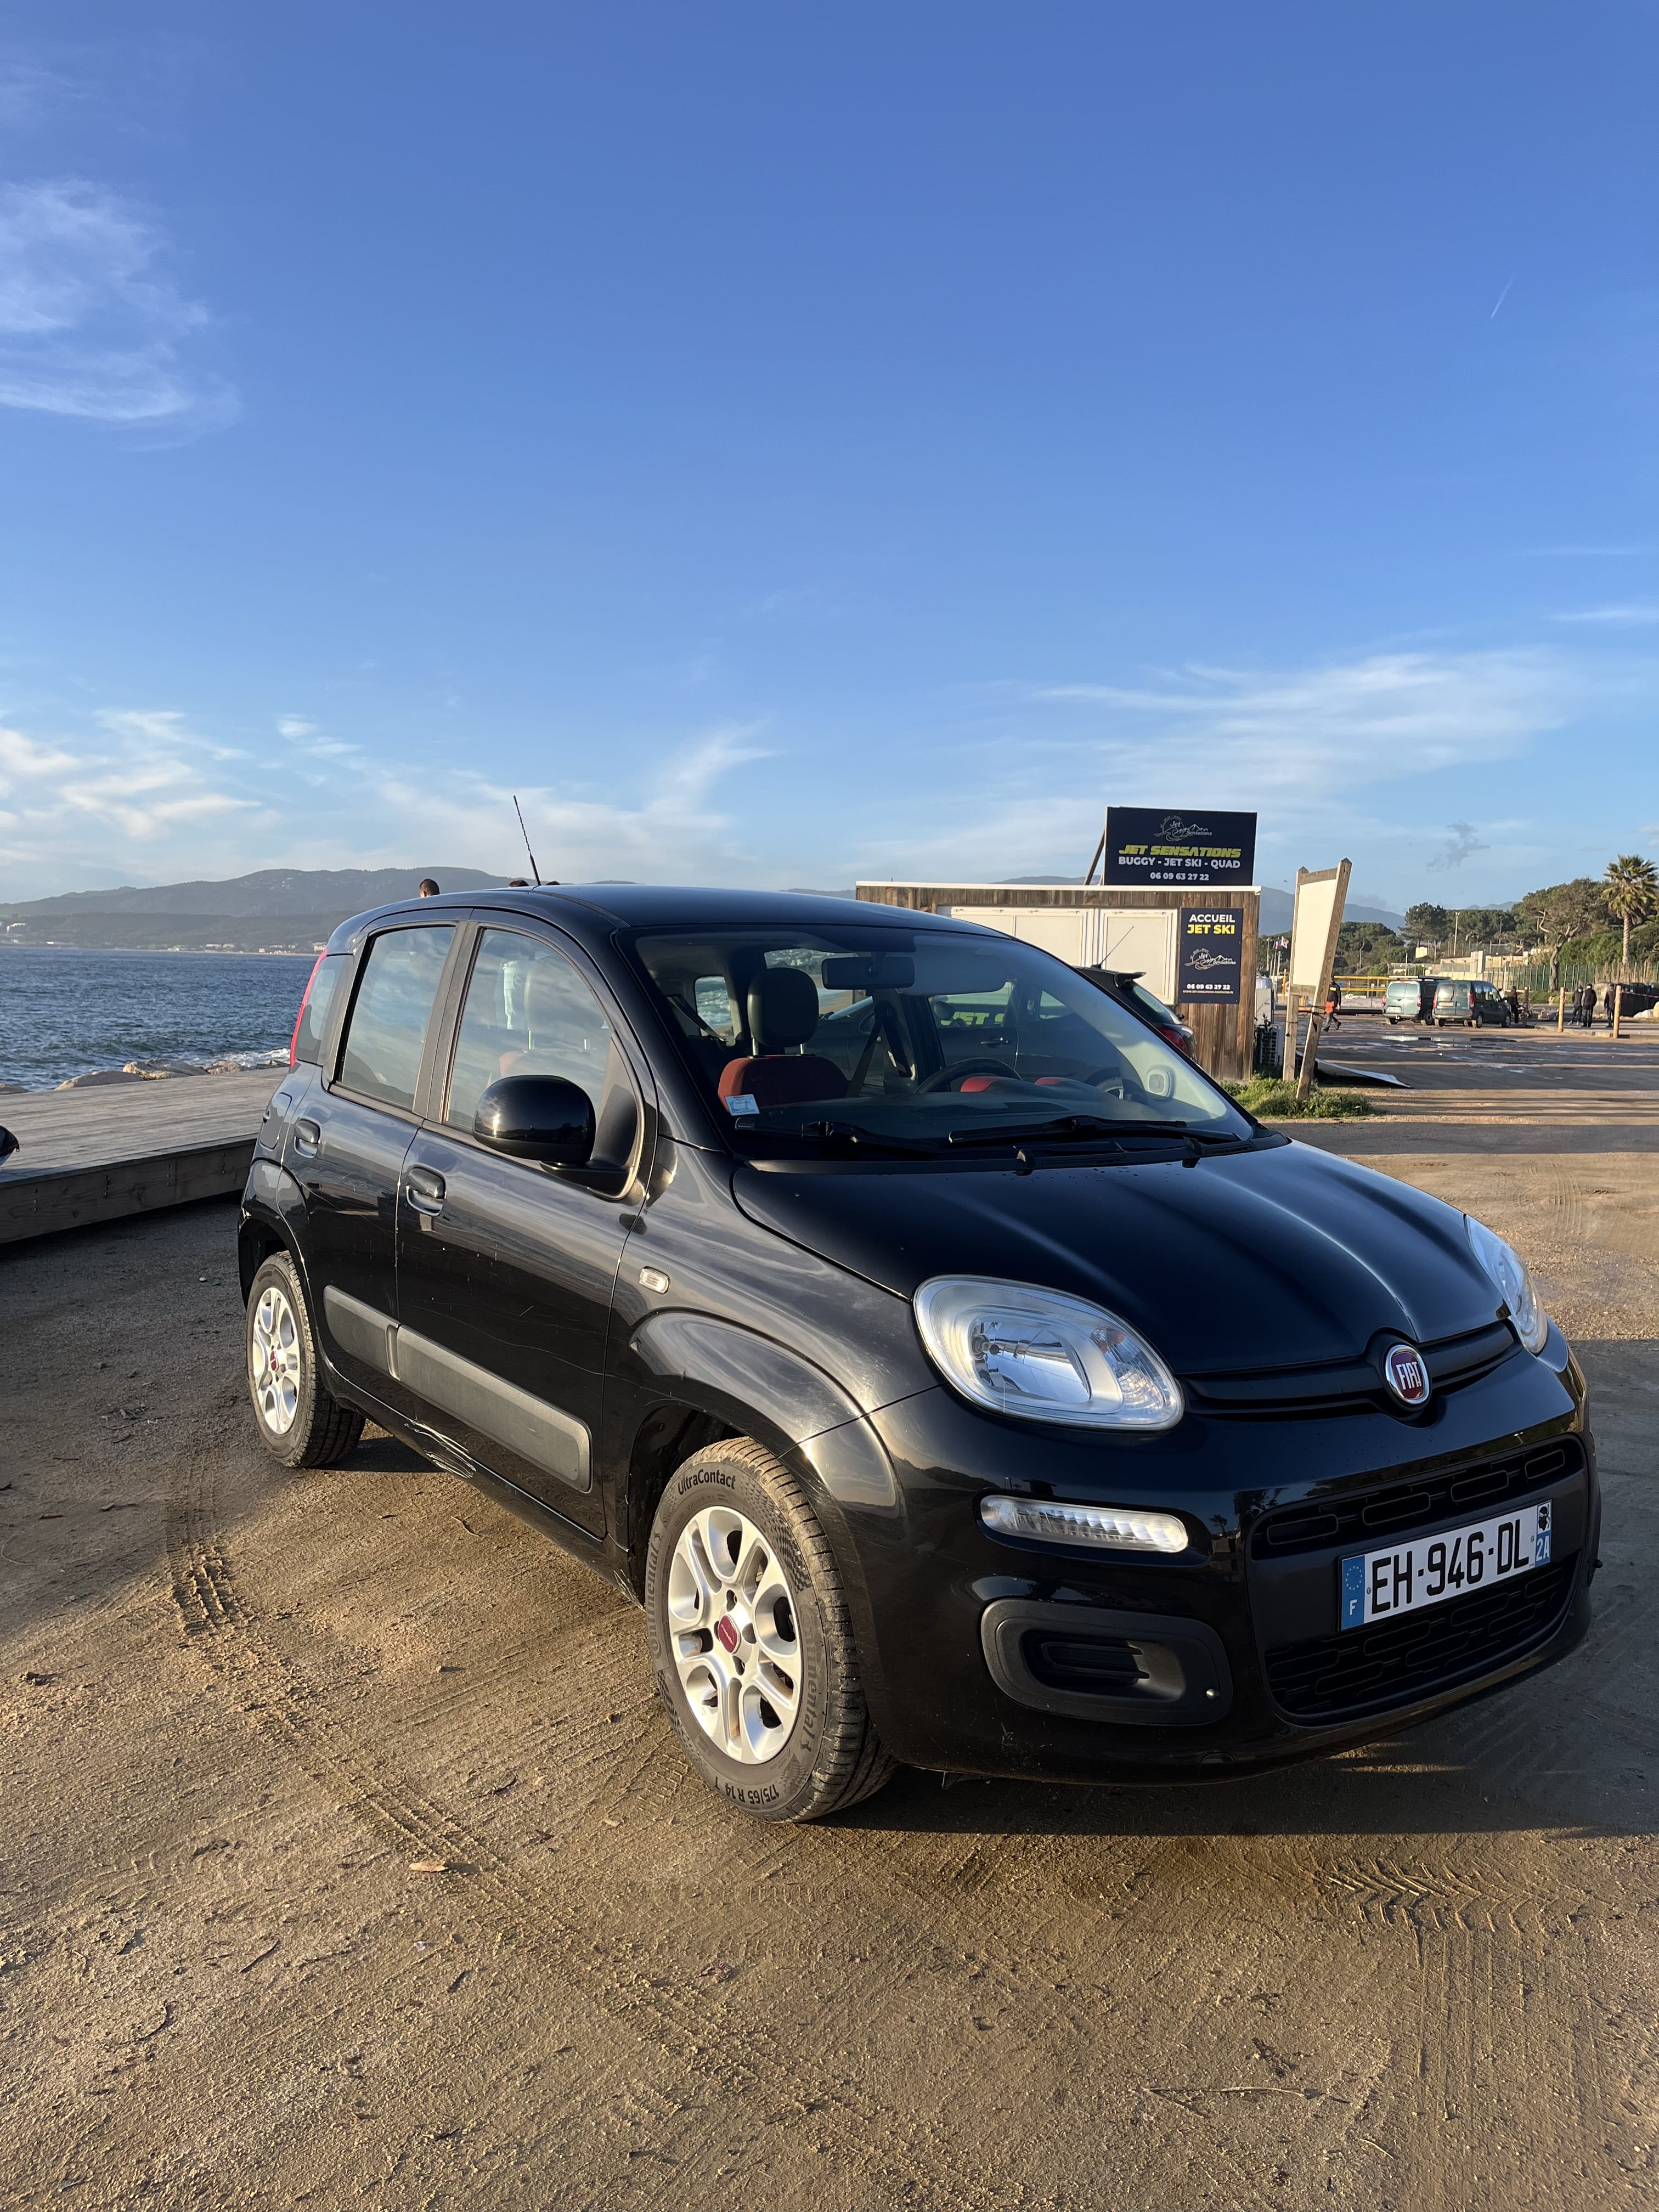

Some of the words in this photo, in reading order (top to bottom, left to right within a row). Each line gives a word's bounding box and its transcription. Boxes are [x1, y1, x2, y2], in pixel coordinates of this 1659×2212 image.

[1119, 845, 1148, 855] JET
[1150, 845, 1242, 858] SENSATIONS
[1118, 856, 1155, 866] BUGGY
[1164, 857, 1183, 866] JET
[1184, 859, 1202, 867] SKI
[1210, 859, 1240, 870] QUAD
[1189, 914, 1235, 923] ACCUEIL
[1187, 924, 1211, 934] JET
[1213, 924, 1235, 934] SKI
[1395, 1361, 1422, 1390] FIAT
[678, 1469, 736, 1496] UltraContact
[1536, 1535, 1550, 1562] 2A
[1349, 1599, 1358, 1616] F
[725, 1782, 736, 1799] 14
[737, 1788, 746, 1803] R
[747, 1784, 780, 1804] 175/65
